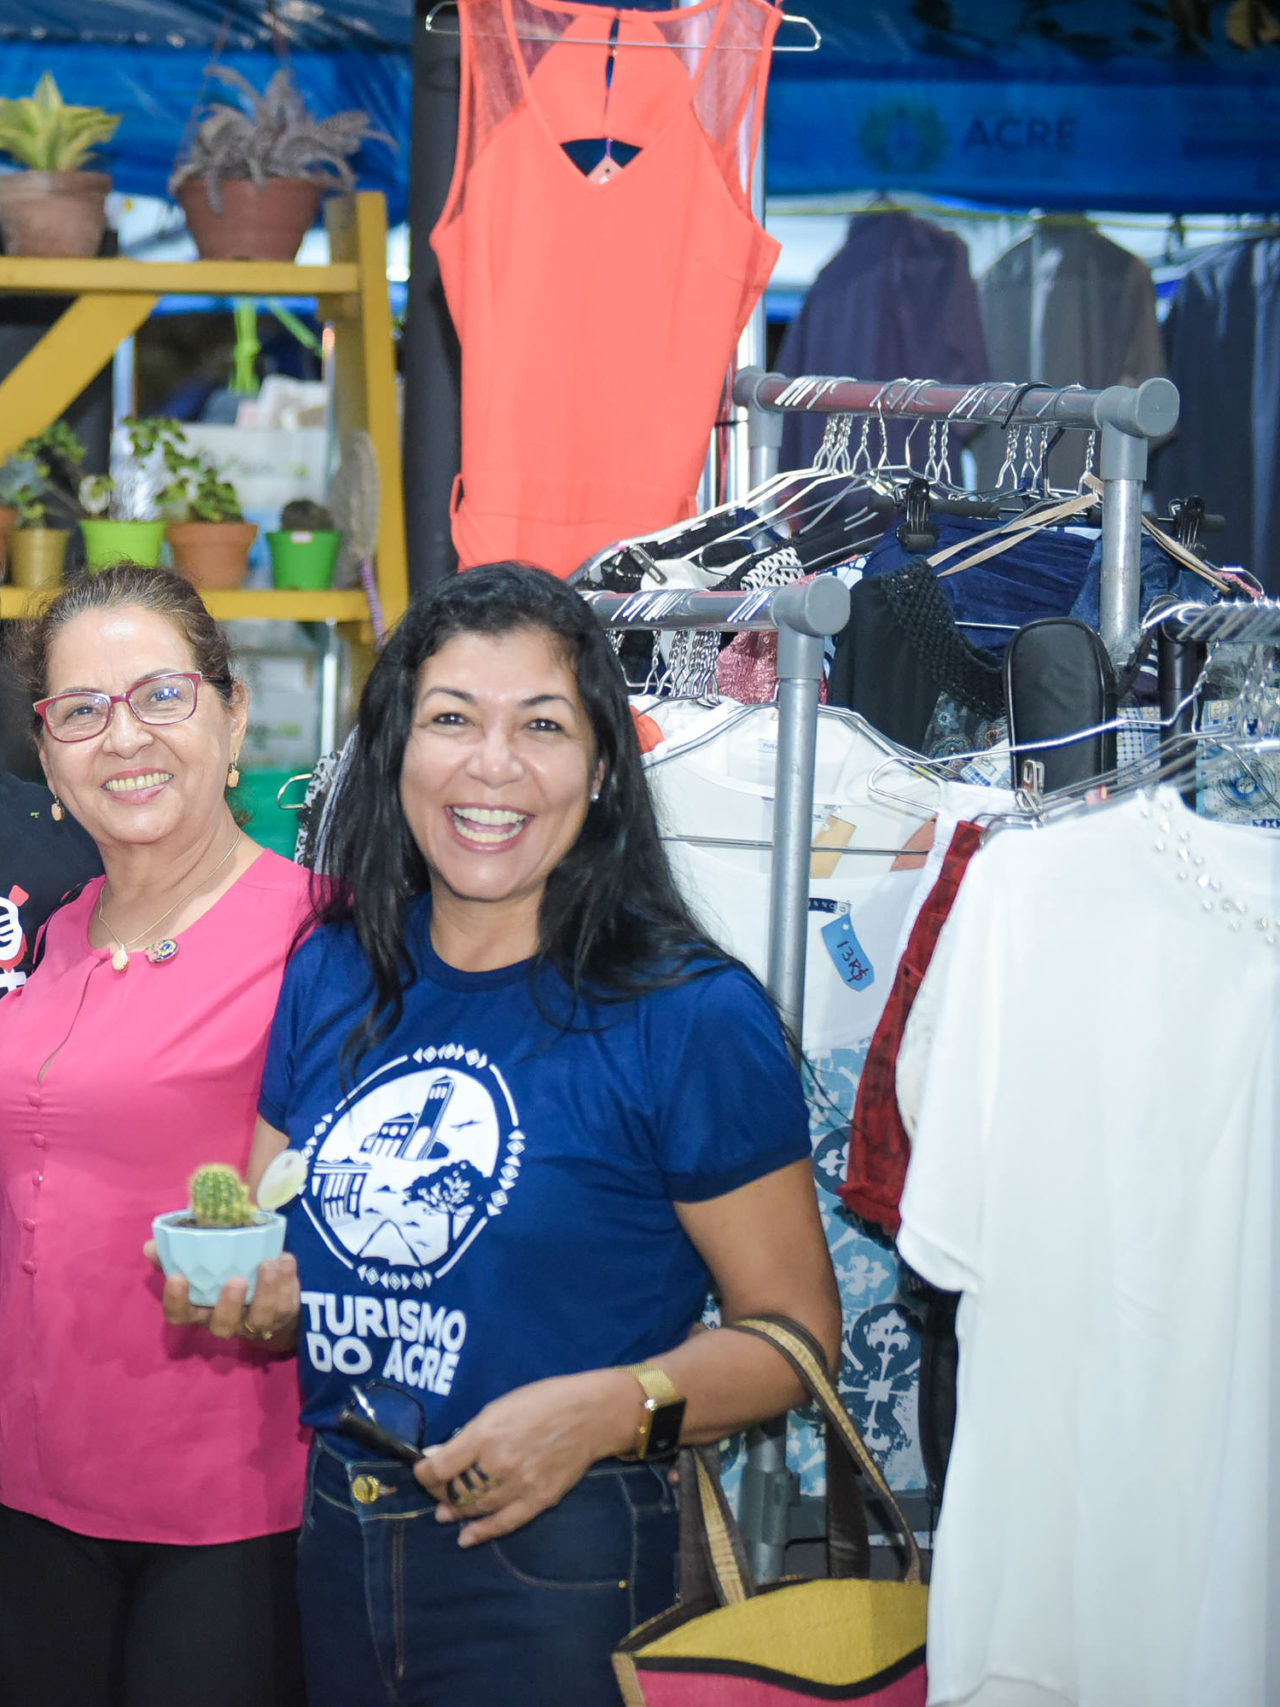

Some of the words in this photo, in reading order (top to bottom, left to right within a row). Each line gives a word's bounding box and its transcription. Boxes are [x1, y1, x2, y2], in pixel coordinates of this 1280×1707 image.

[963, 116, 1079, 153] ACRE
[300, 1291, 467, 1353] TURISMO
[306, 1331, 373, 1375] DO
[382, 1339, 460, 1397] ACRE
